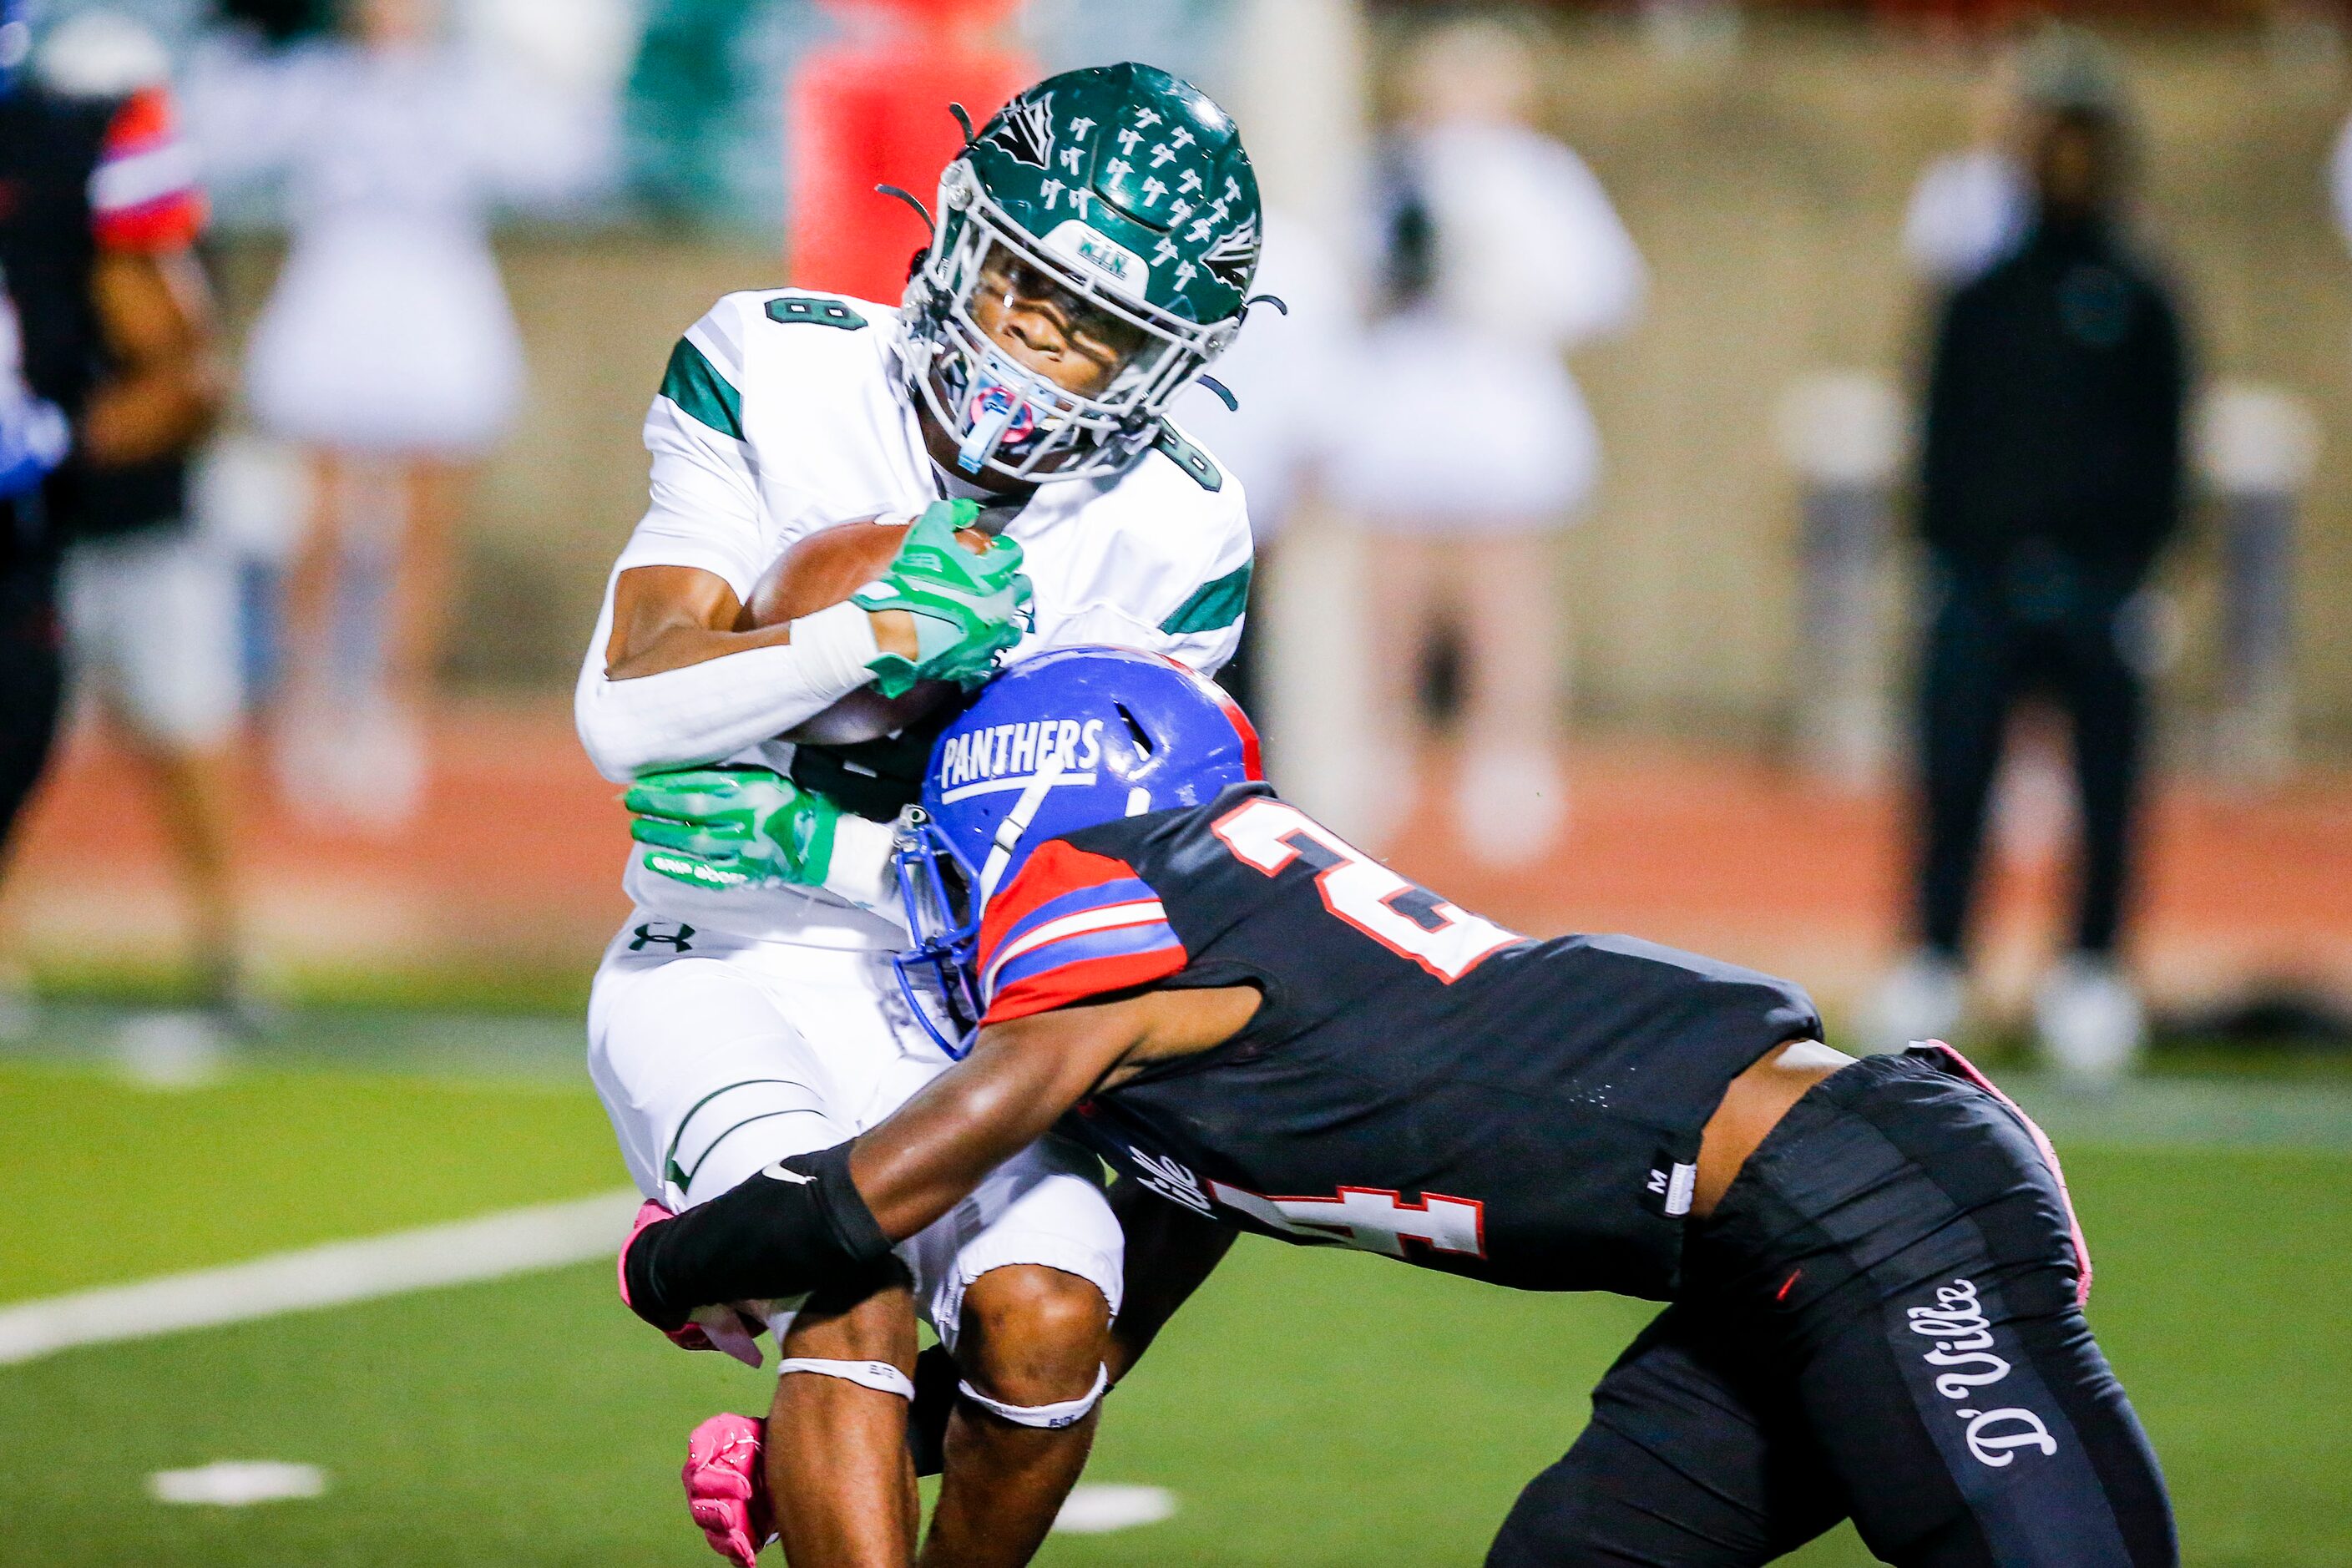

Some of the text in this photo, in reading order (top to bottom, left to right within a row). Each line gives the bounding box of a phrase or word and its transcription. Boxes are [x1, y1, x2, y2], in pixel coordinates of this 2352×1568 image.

[764, 297, 869, 331] 8
[941, 718, 1105, 790] PANTHERS
[1210, 797, 1529, 985] 2
[1646, 1168, 1668, 1194] M
[1205, 1185, 1488, 1260] 4
[1906, 1278, 2058, 1468] D'Ville
